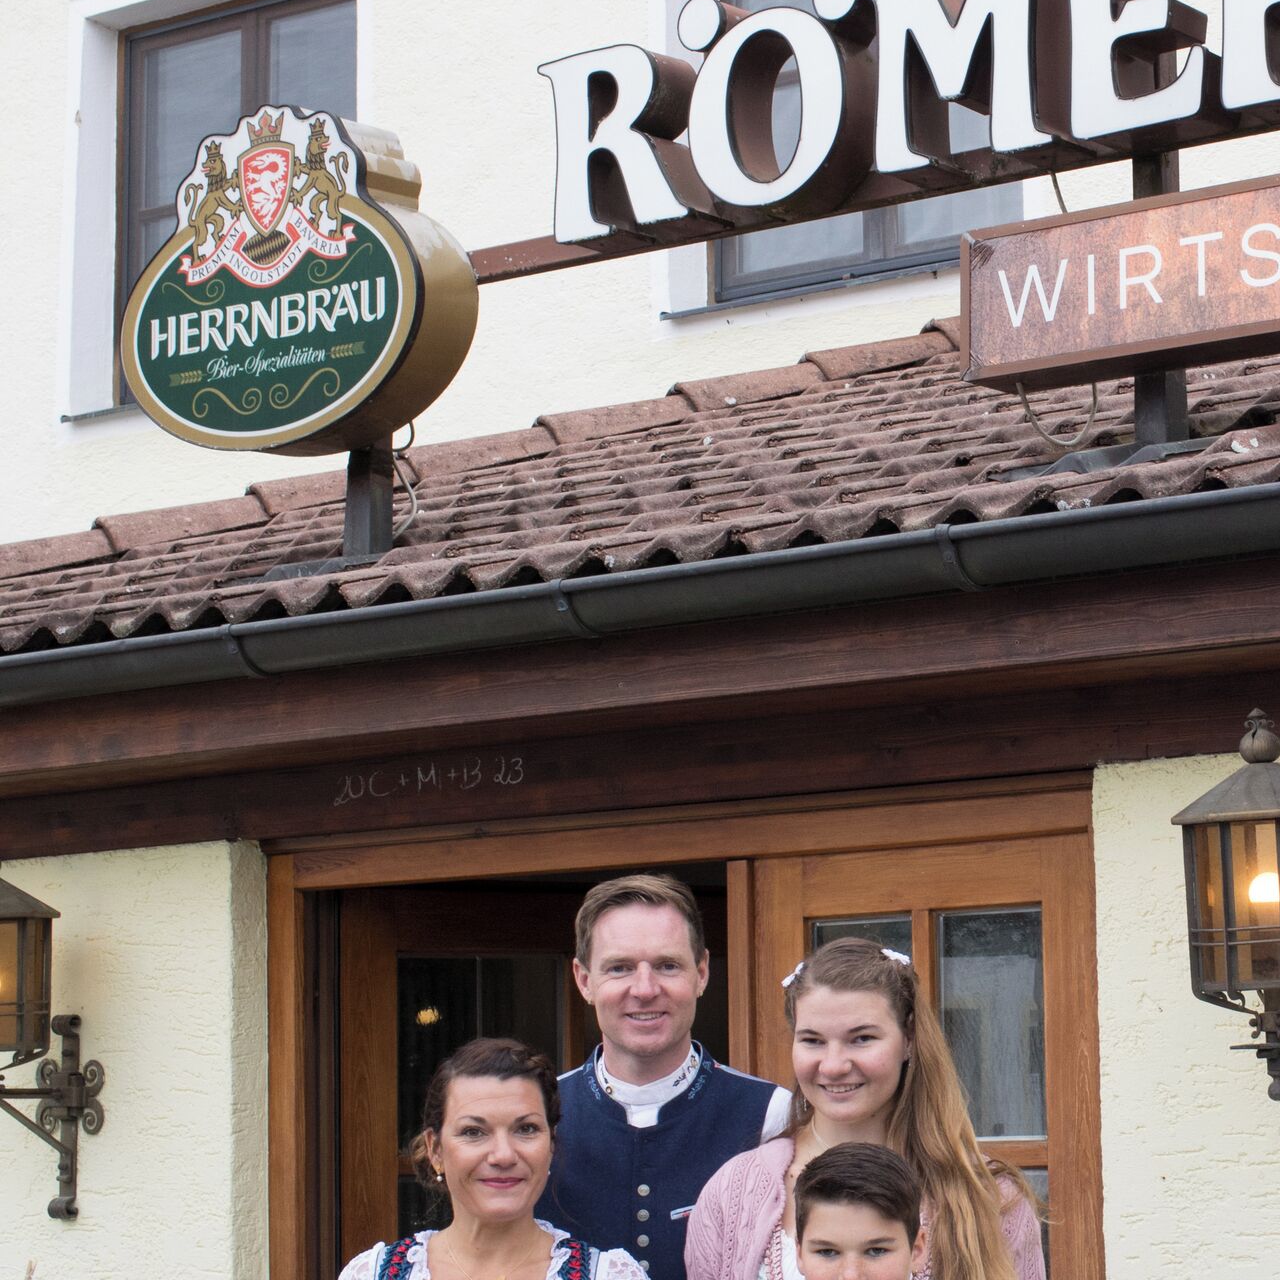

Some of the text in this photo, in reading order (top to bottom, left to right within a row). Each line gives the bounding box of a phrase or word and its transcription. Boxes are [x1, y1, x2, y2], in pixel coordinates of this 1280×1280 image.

[192, 227, 240, 281] PREMIUM
[294, 217, 341, 254] BAVARIA
[229, 243, 303, 284] INGOLSTADT
[151, 276, 386, 361] HERRNBRÄU
[207, 346, 326, 382] Bier-Spezialitäten
